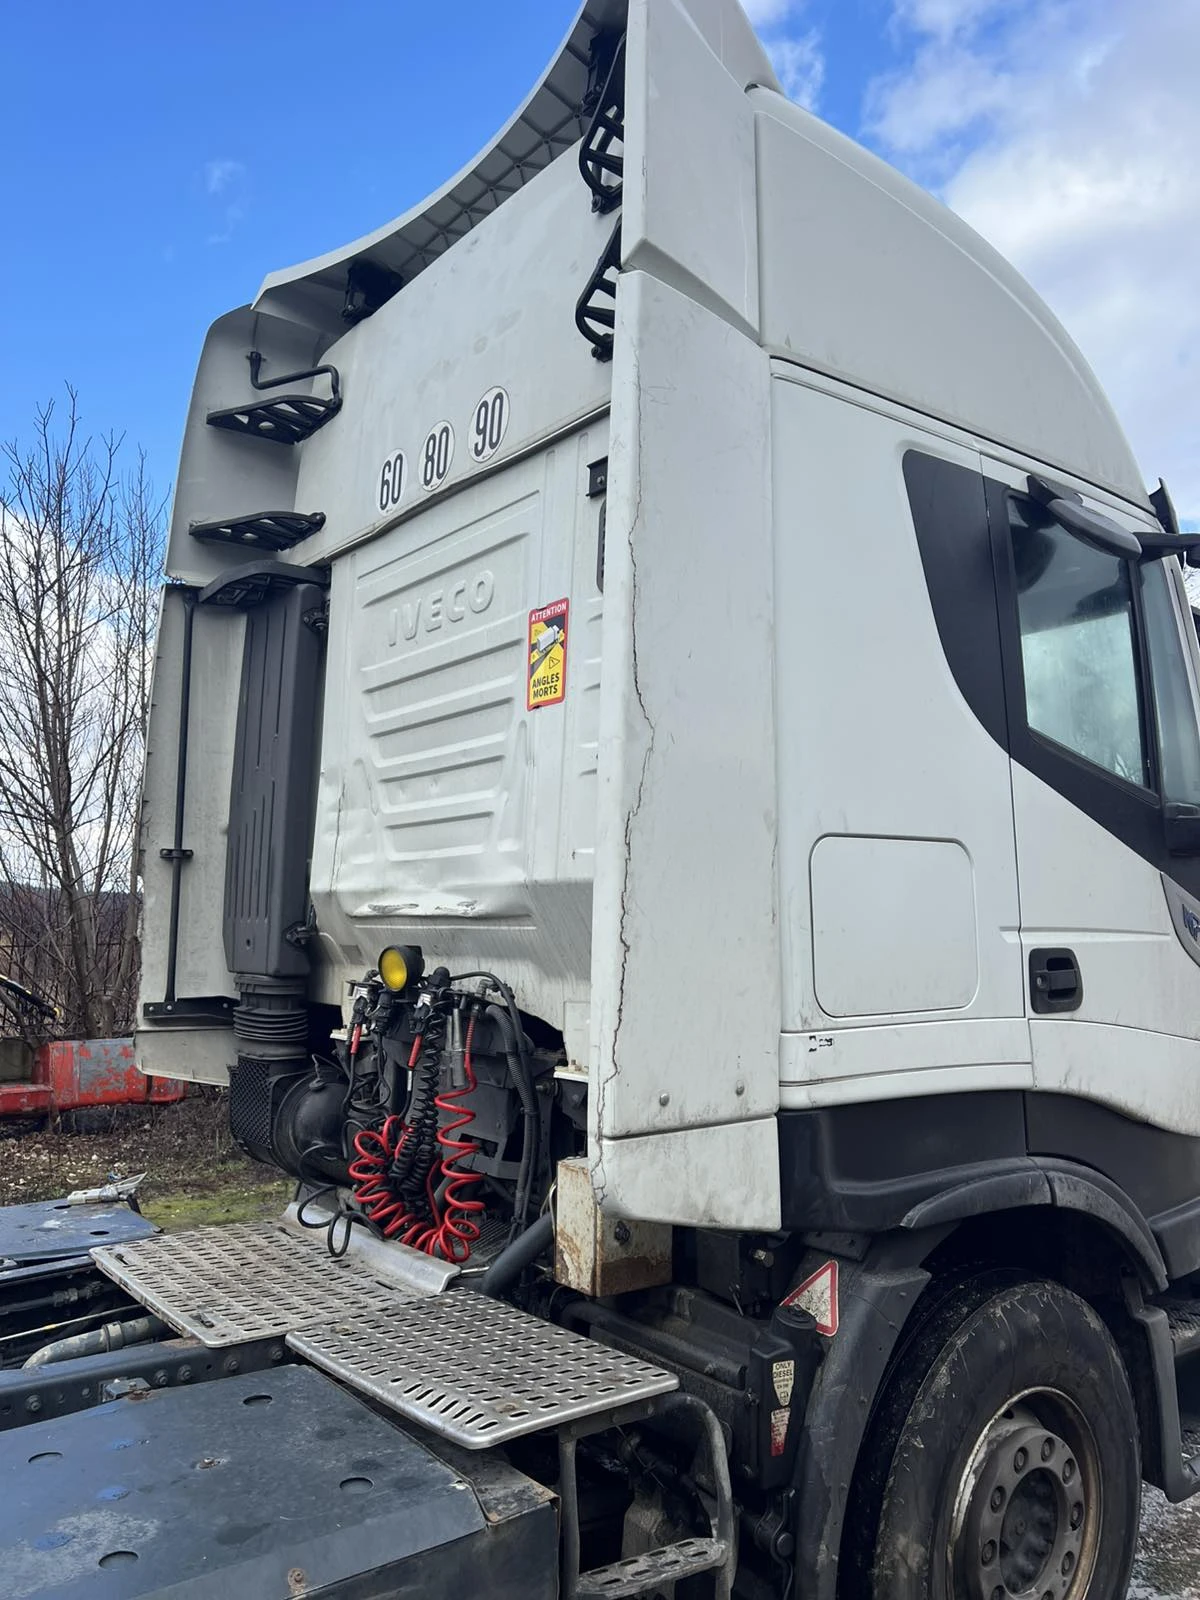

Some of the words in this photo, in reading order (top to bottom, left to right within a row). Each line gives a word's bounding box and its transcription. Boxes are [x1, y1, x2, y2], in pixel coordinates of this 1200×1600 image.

[474, 392, 504, 457] 90
[424, 426, 450, 486] 80
[380, 453, 403, 511] 60
[387, 571, 495, 647] IVECO
[531, 601, 567, 622] ATTENTION
[532, 672, 560, 689] ANGLES
[533, 684, 558, 699] MORTS
[773, 1369, 792, 1378] DIESEL
